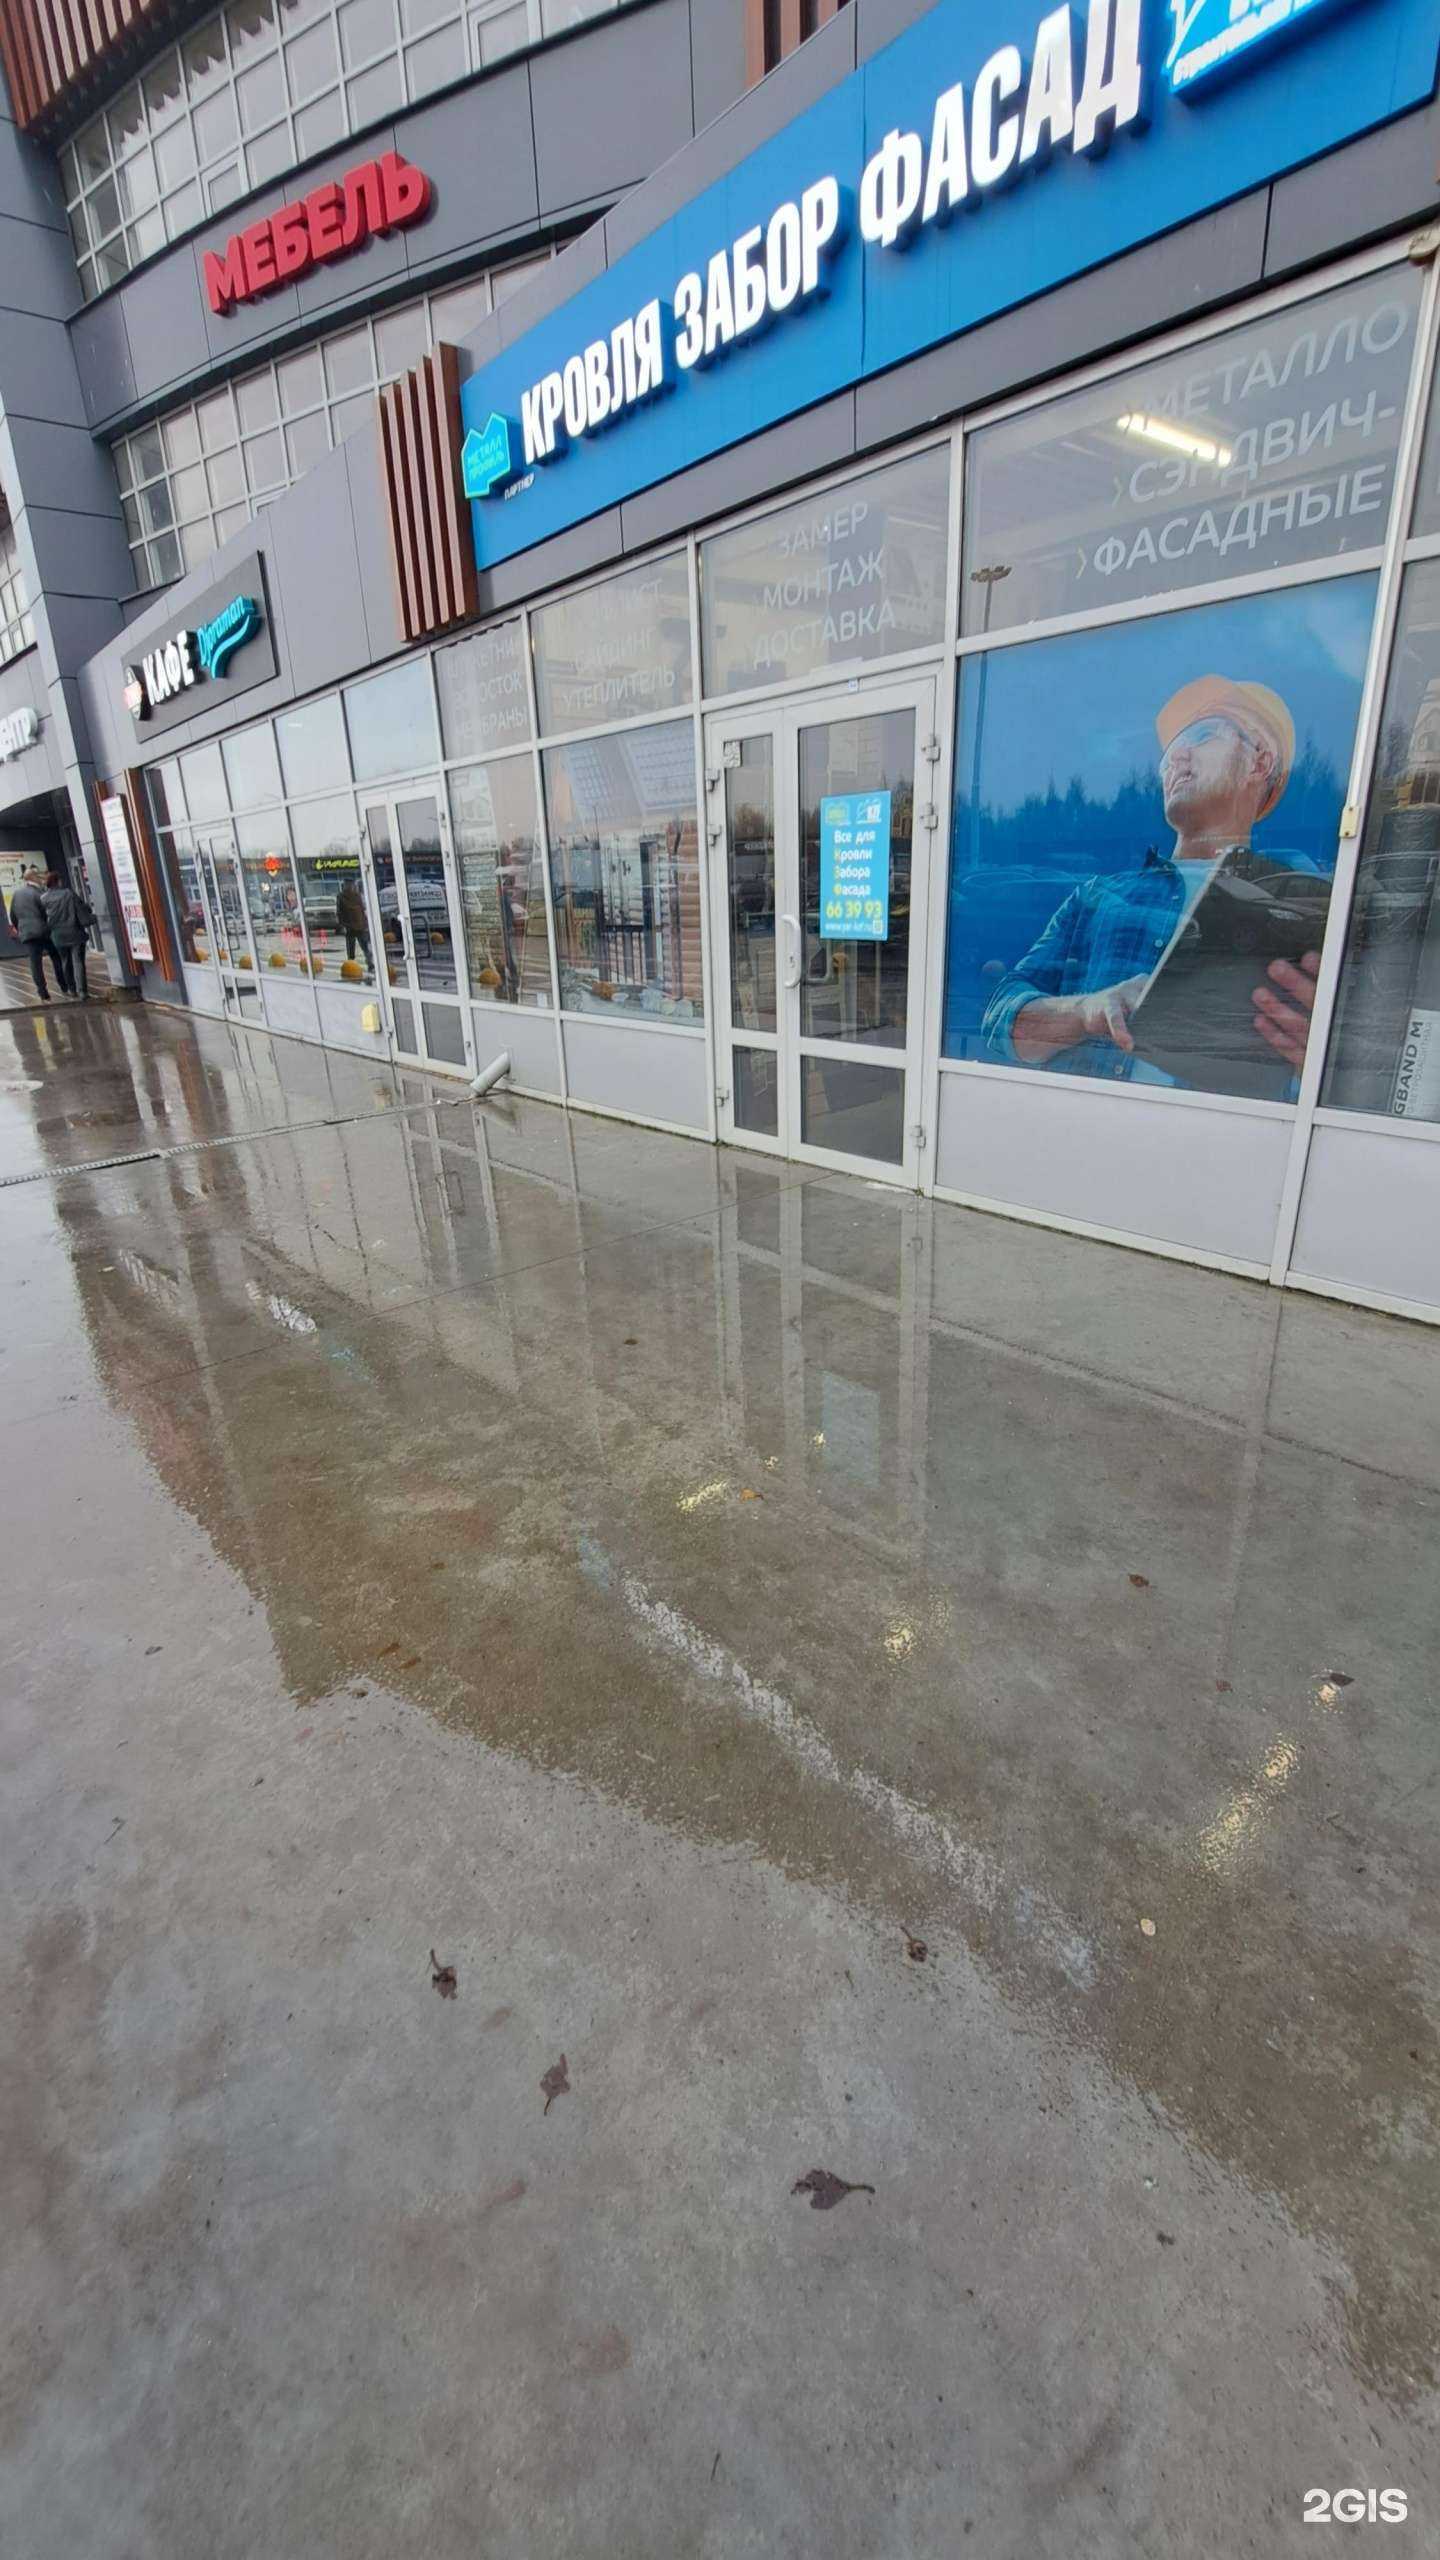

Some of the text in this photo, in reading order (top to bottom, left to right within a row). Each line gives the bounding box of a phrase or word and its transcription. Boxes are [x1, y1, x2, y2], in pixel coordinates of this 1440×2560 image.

[203, 150, 432, 316] МЕБЕЛЬ
[520, 298, 664, 466] КРОВЛЯ
[672, 176, 840, 368] ЗАБОР
[859, 0, 1142, 247] ФАСАД
[778, 502, 869, 559] ЗАМЕР
[1093, 463, 1387, 576] ФАСАДНЫЕ
[763, 543, 888, 614] МОНТАЖ
[753, 599, 897, 671] ДОСТАВКА
[142, 630, 196, 706] КАФЕ
[834, 830, 876, 846] Все для
[834, 850, 873, 865] Кровли
[833, 884, 871, 899] Фасада
[834, 866, 871, 882] Забора
[826, 901, 883, 919] 66 39 93
